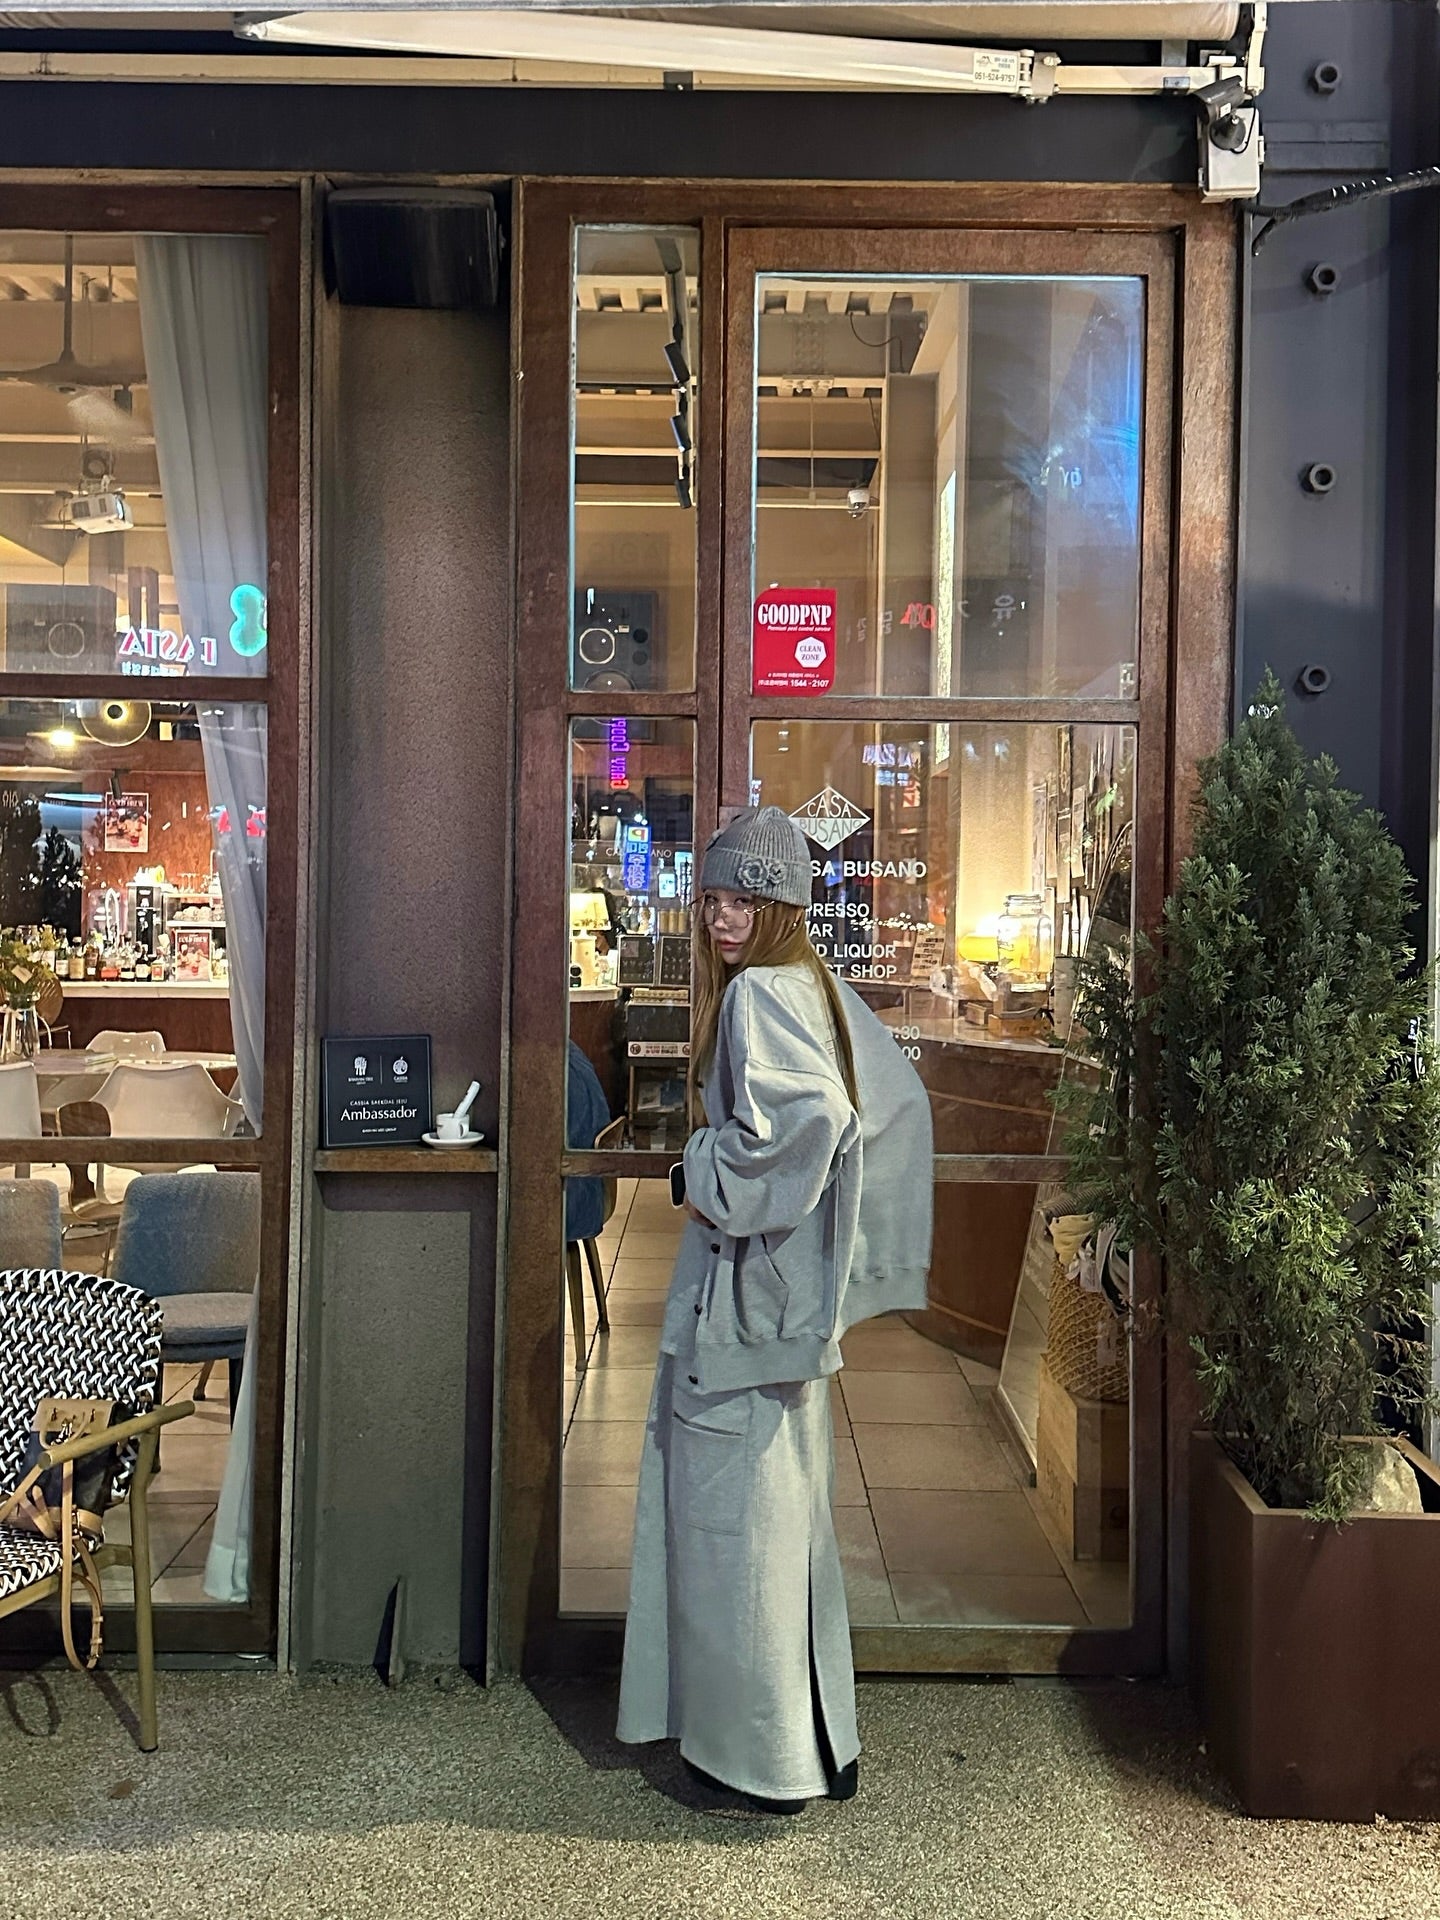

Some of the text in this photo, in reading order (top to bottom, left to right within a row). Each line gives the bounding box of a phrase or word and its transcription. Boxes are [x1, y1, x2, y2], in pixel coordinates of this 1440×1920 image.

[974, 71, 1015, 82] 051-524-9757
[757, 603, 832, 626] GOODPNP
[799, 645, 822, 653] CLEAN
[801, 653, 820, 661] ZONE
[806, 794, 852, 818] CASA
[799, 819, 863, 843] BUSANO
[810, 859, 927, 878] SA BUSANO
[833, 943, 897, 959] LIQUOR
[850, 964, 897, 979] SHOP
[340, 1105, 418, 1121] Ambassador
